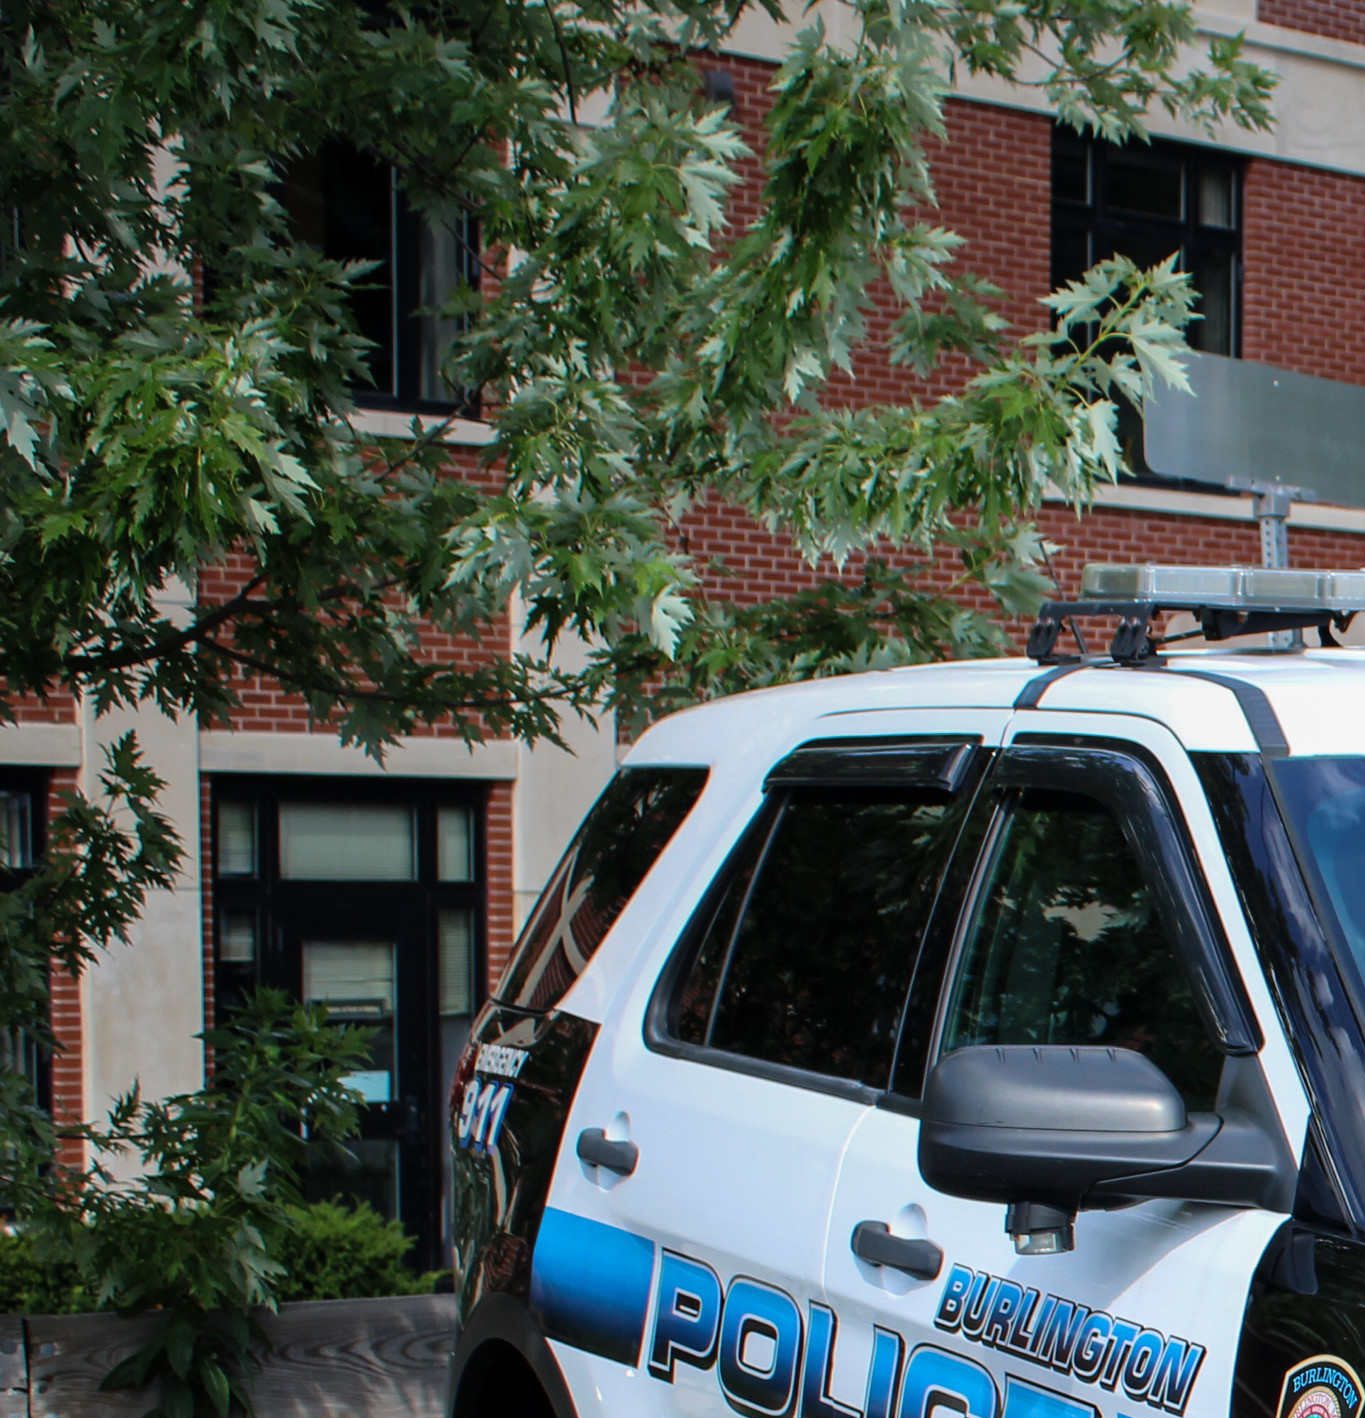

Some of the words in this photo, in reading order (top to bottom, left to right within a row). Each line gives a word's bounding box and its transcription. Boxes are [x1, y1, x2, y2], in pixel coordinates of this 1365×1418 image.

[458, 1076, 514, 1155] 911
[934, 1263, 1207, 1418] BURLINGTON
[1292, 1366, 1358, 1409] BURLINGTON
